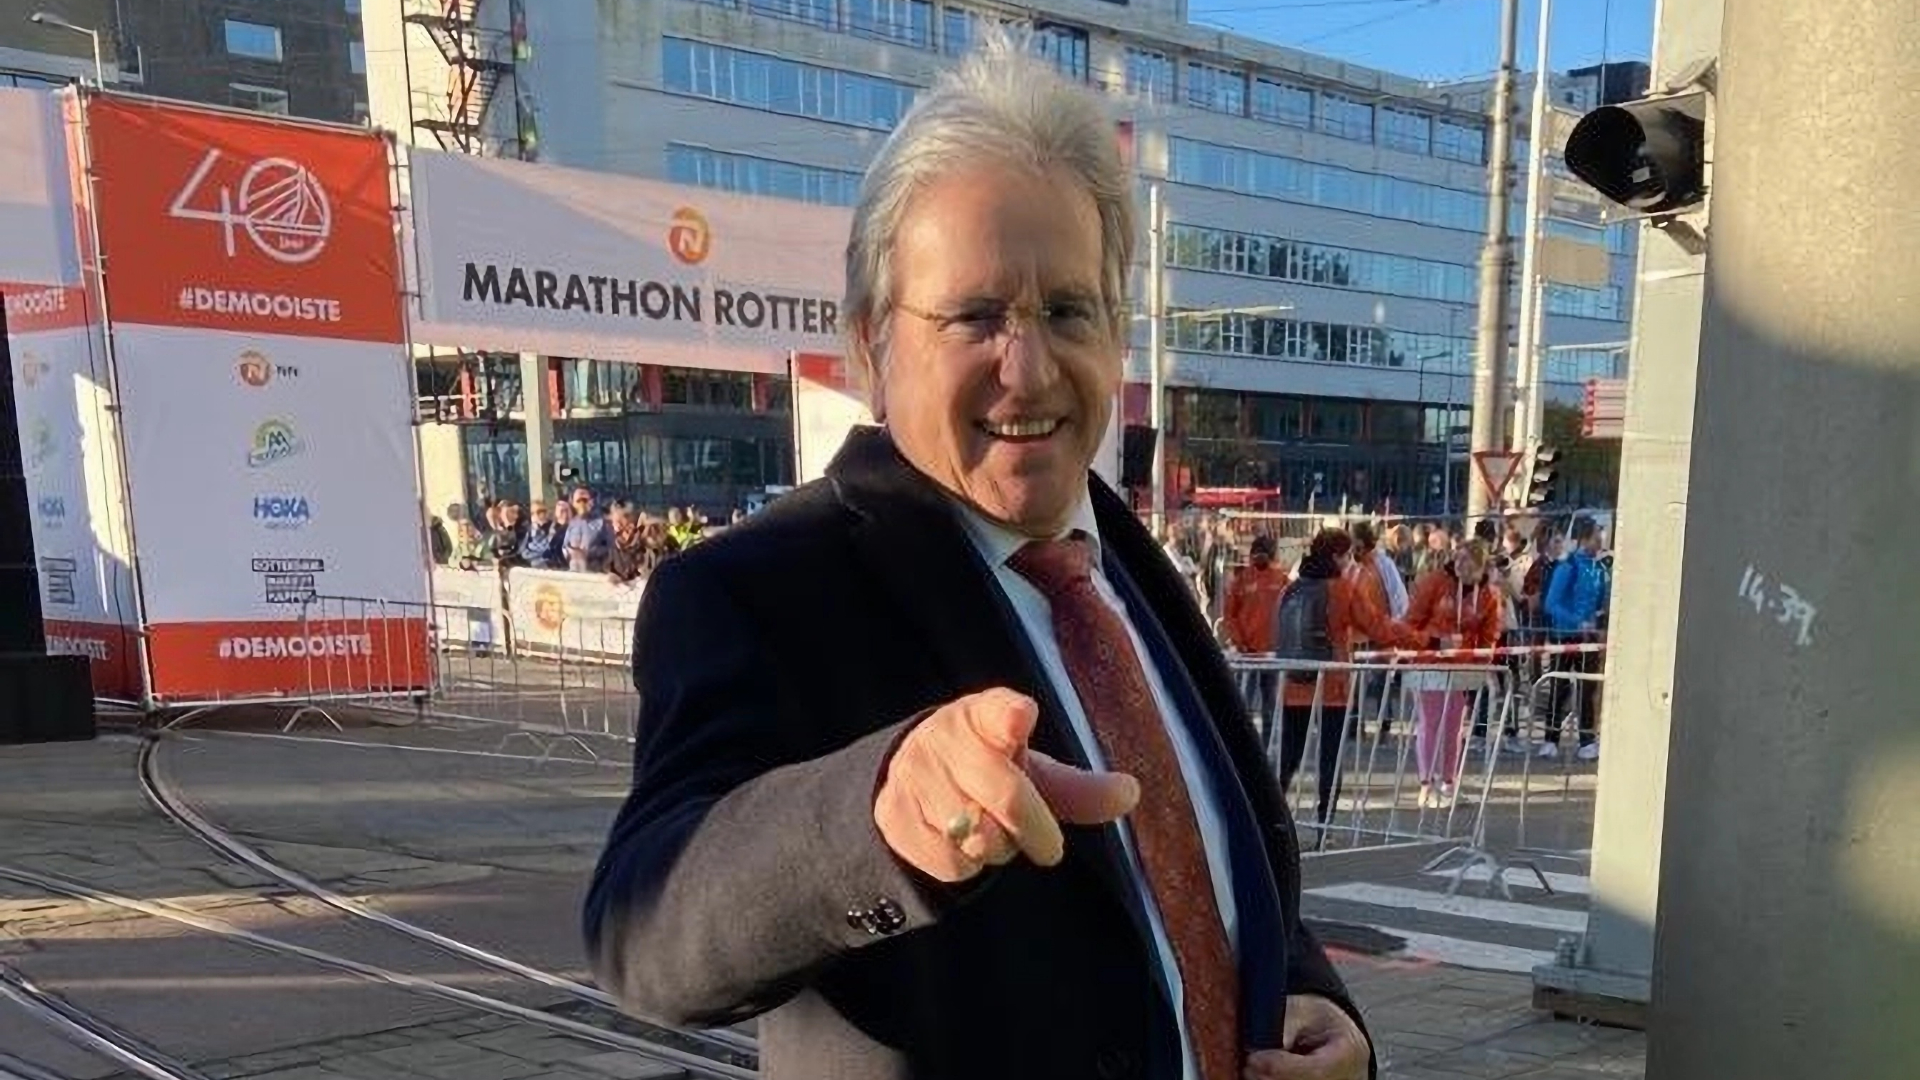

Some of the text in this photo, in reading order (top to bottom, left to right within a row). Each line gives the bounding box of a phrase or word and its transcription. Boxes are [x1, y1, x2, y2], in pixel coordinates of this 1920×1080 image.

[180, 286, 342, 322] #DEMOOISTE
[463, 262, 838, 335] MARATHON ROTTER
[253, 495, 309, 519] HOKA
[219, 633, 373, 659] #DEMOOISTE
